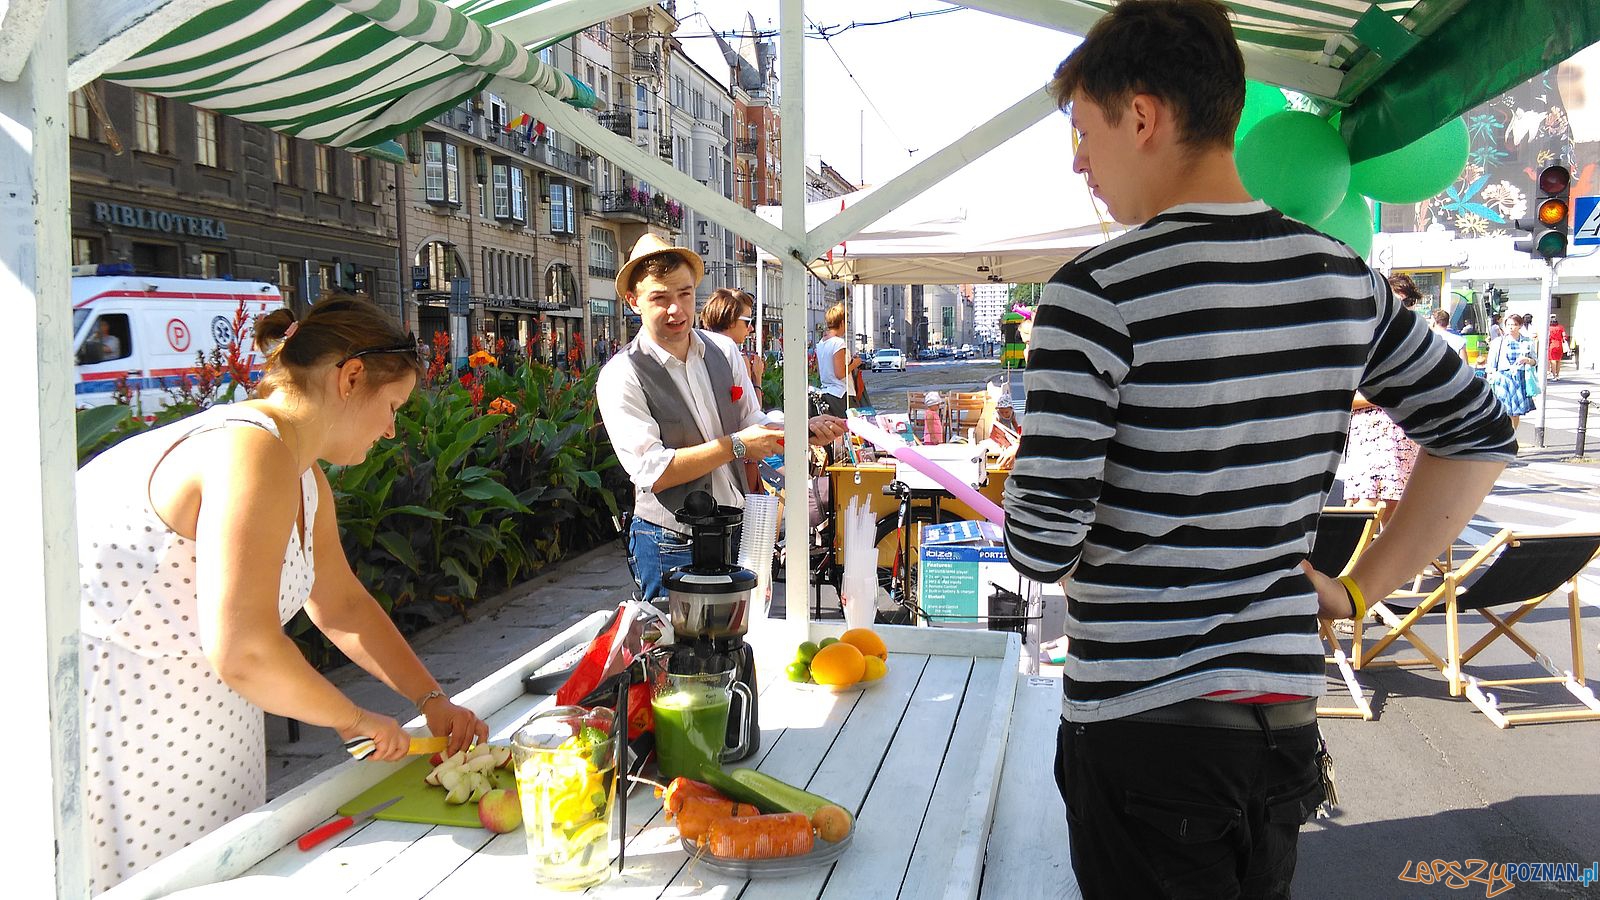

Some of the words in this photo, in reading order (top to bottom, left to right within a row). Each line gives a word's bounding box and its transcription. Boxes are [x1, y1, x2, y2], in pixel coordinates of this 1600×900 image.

[94, 201, 228, 240] BIBLIOTEKA
[486, 297, 517, 307] HOTEL
[173, 326, 184, 345] P
